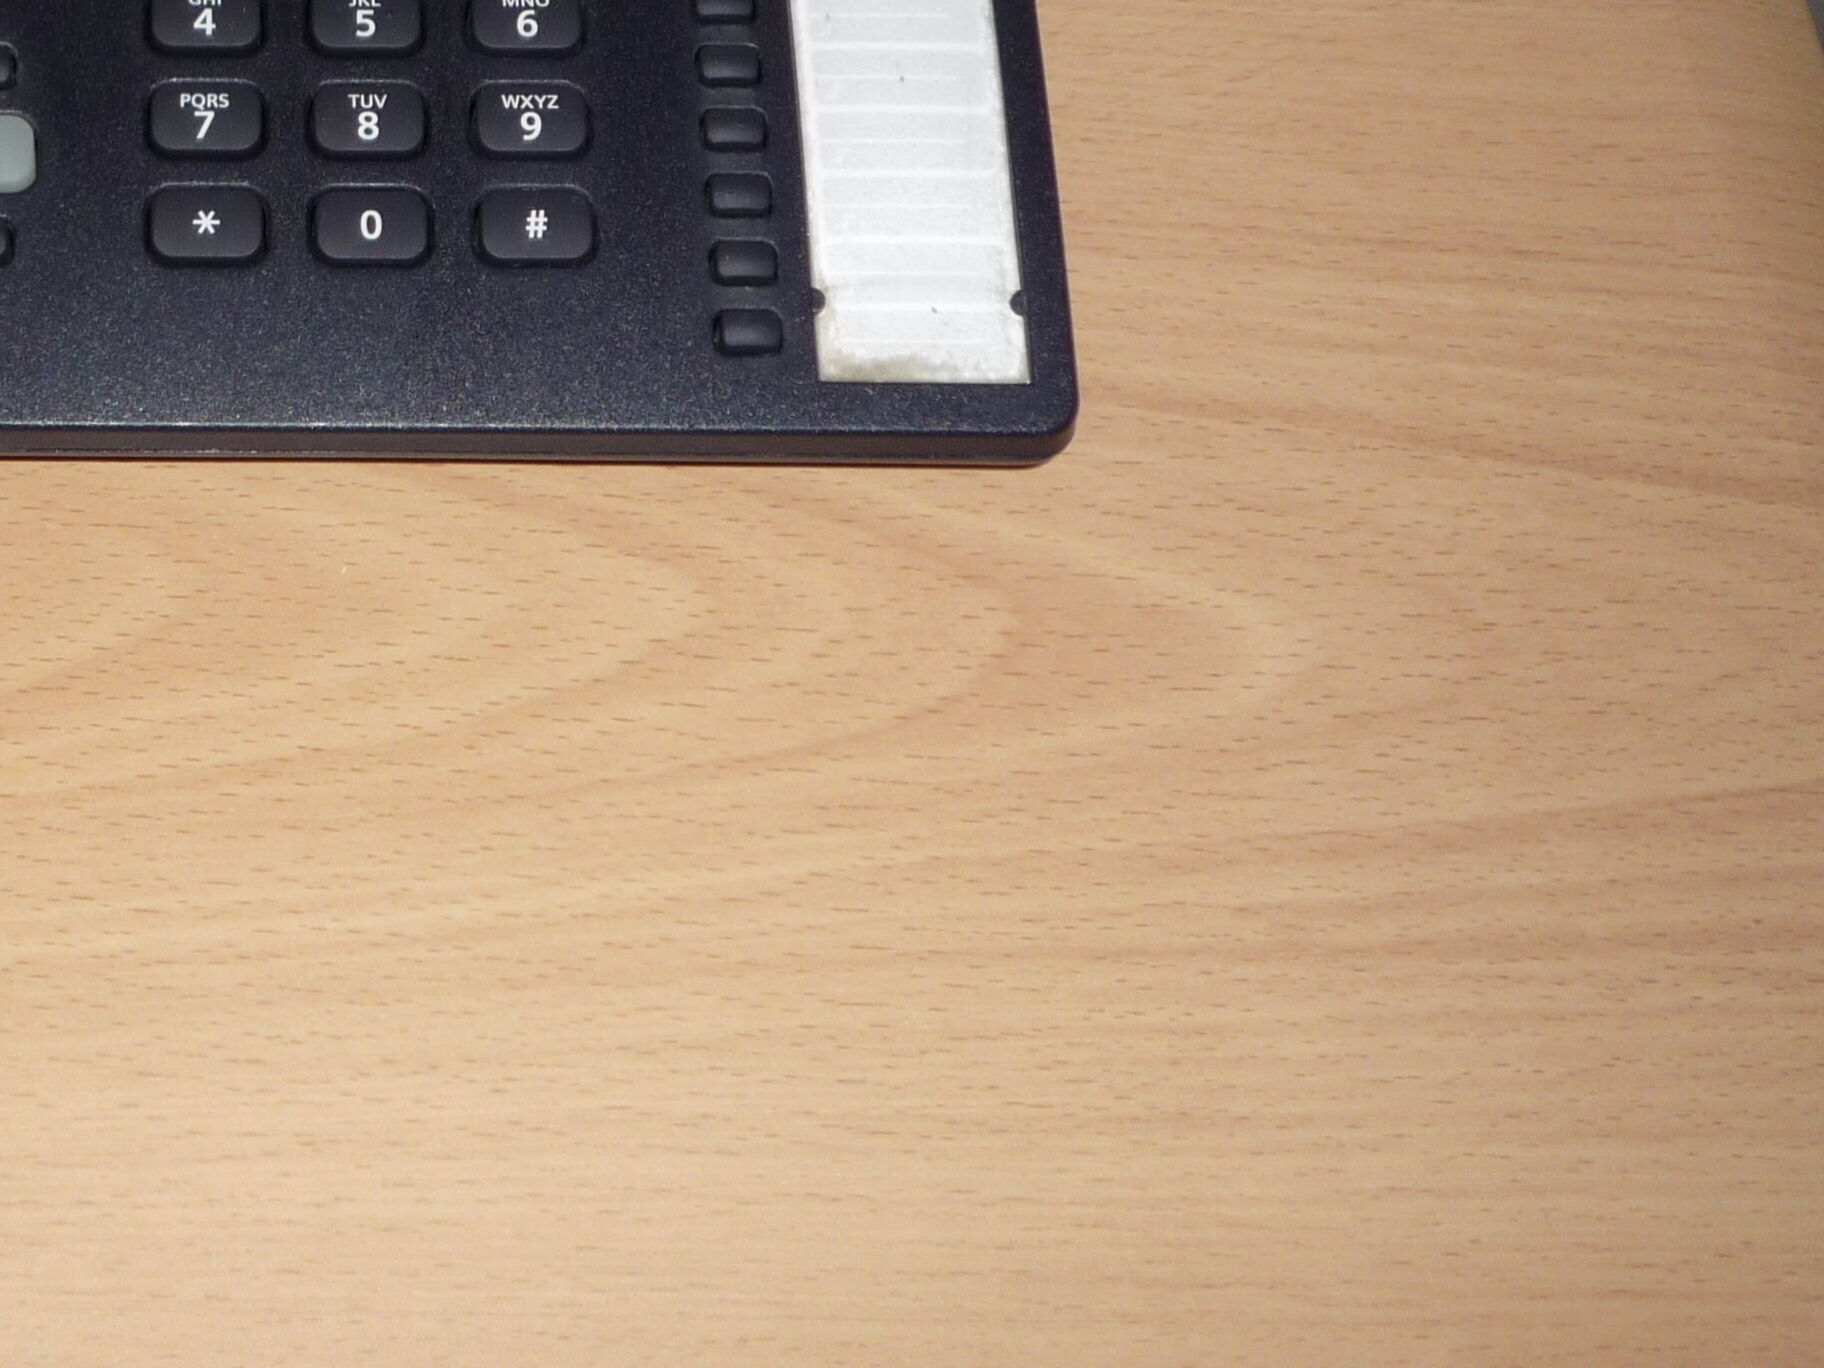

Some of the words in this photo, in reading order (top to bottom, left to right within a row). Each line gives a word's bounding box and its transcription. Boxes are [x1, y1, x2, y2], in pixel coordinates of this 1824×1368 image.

[192, 7, 217, 36] 4
[355, 9, 376, 38] 5
[516, 9, 539, 38] 6
[179, 93, 230, 110] PQRS
[347, 93, 388, 109] TUV
[500, 94, 560, 110] WXYZ
[193, 111, 215, 140] 7
[357, 110, 380, 141] 8
[520, 111, 542, 141] 9
[360, 209, 383, 241] 0
